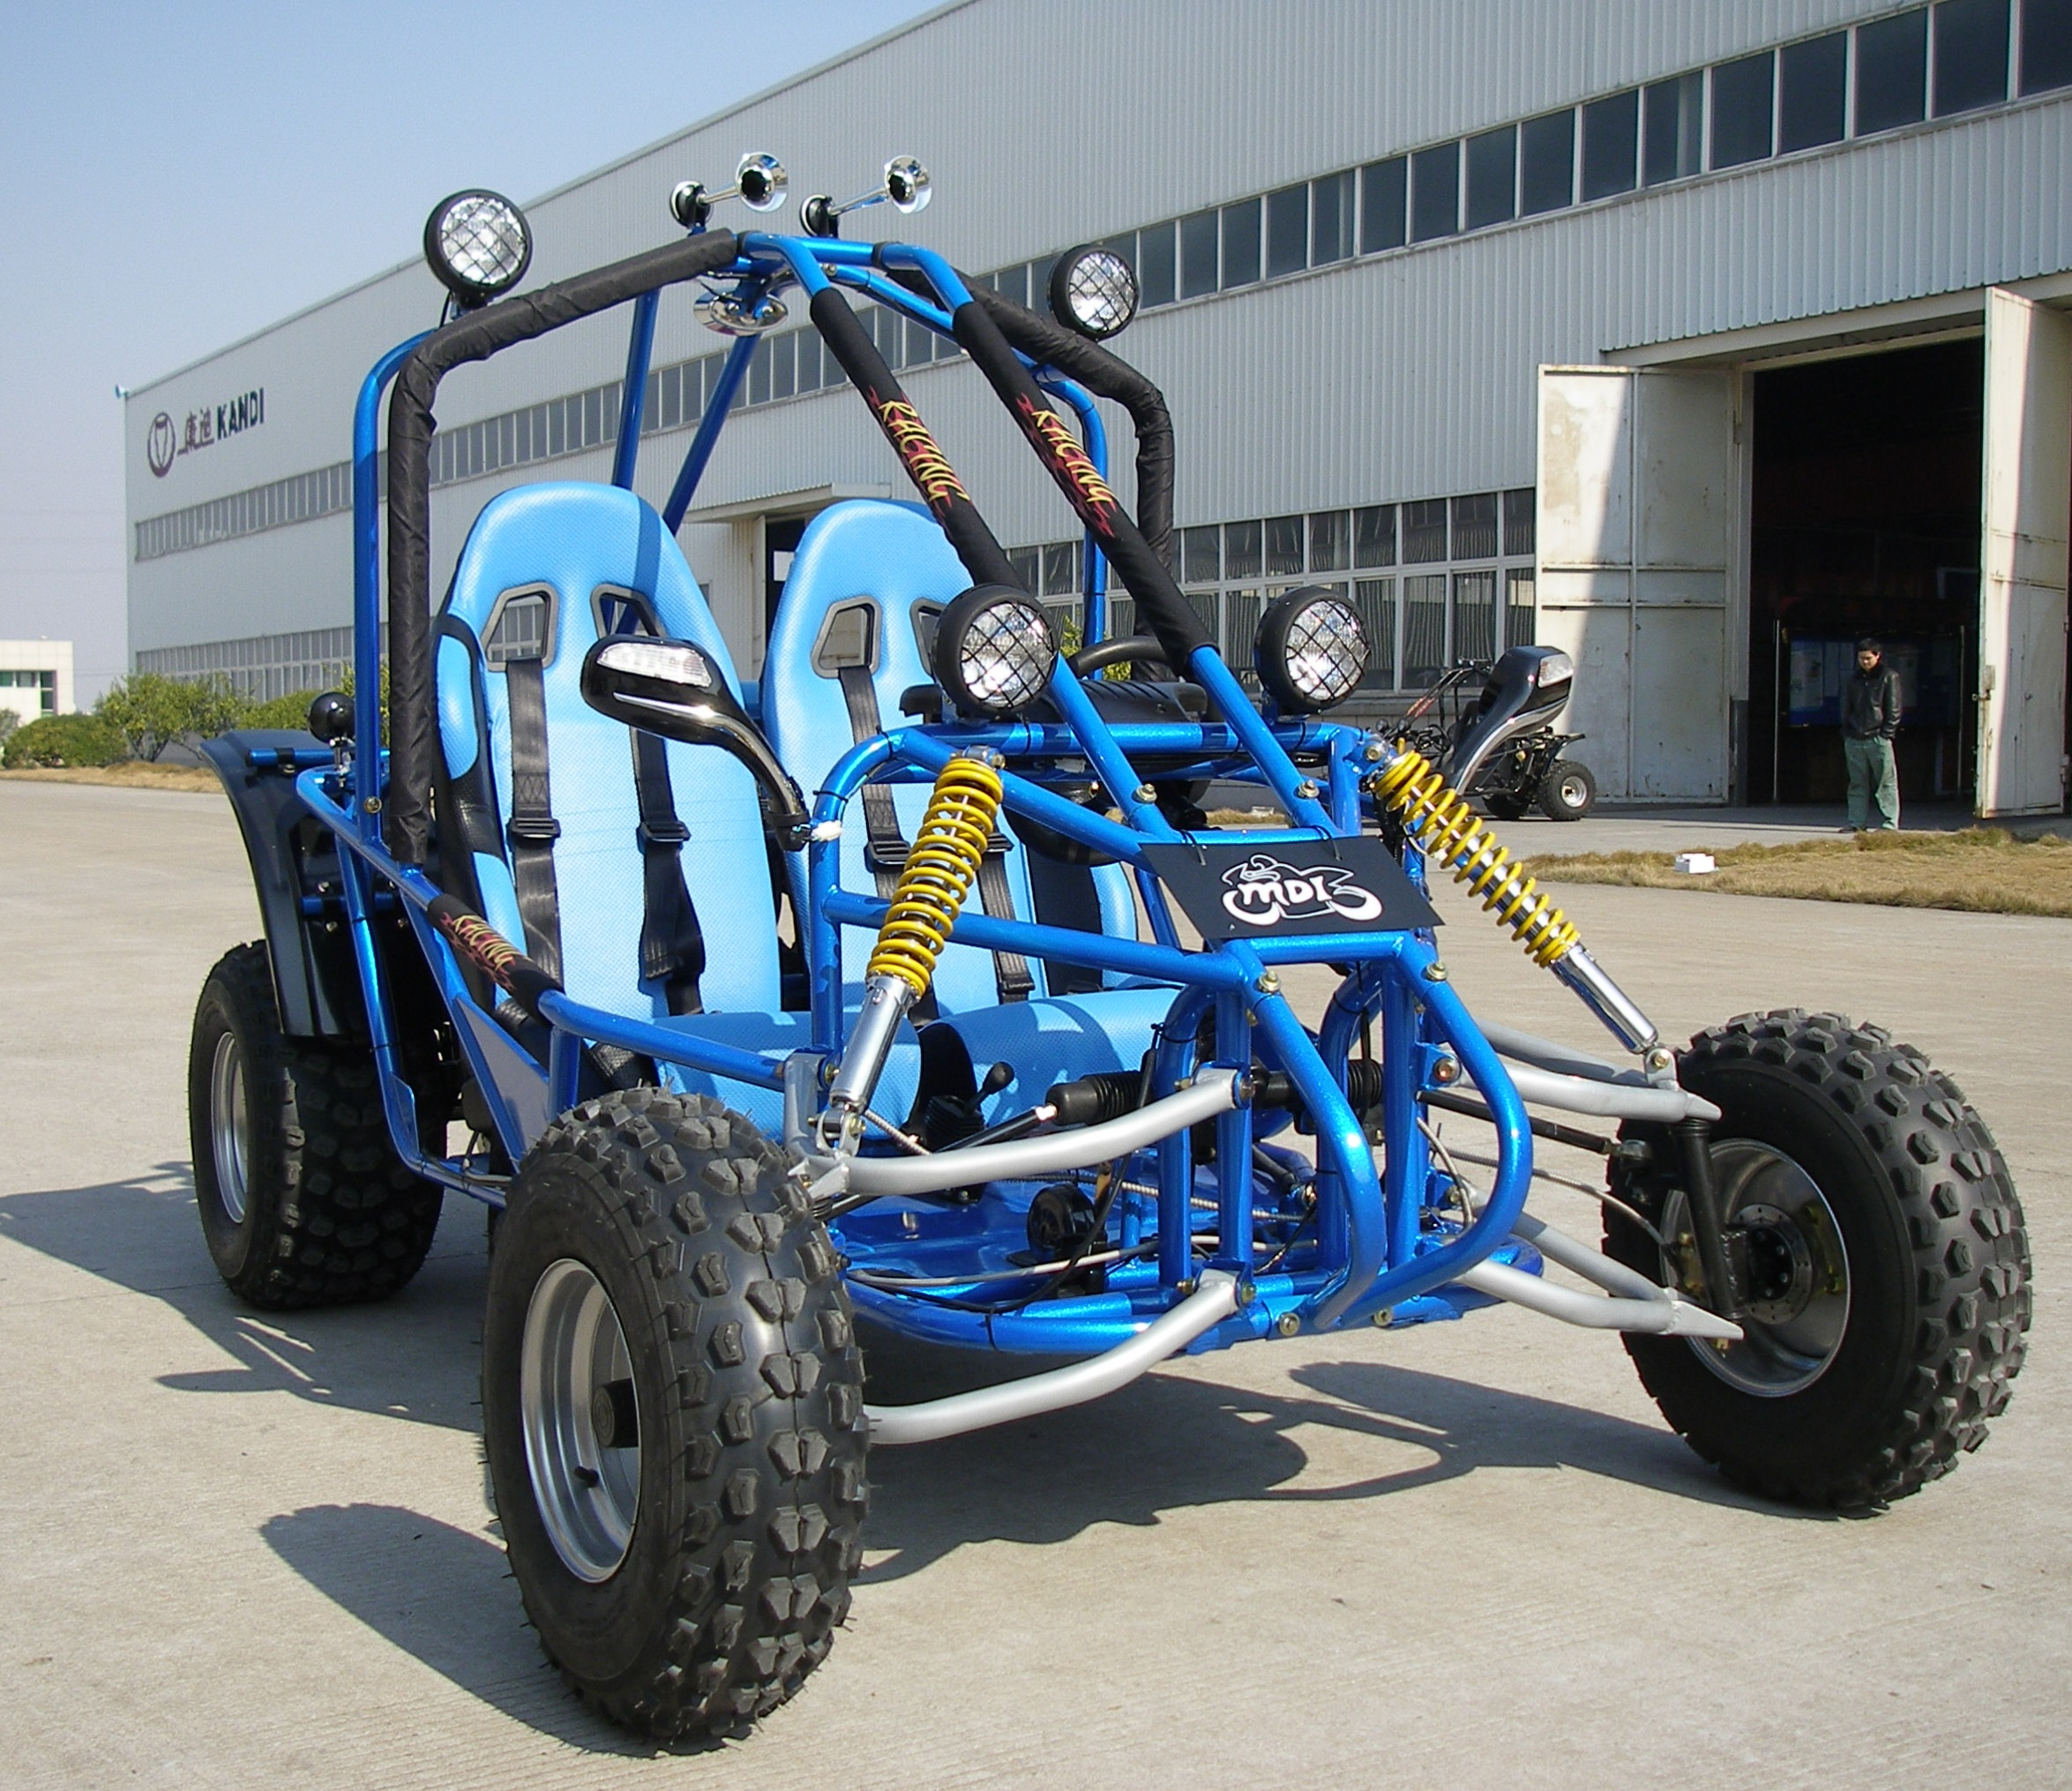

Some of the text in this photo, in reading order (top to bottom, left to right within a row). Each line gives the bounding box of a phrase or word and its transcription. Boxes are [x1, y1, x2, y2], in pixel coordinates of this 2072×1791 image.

[217, 387, 264, 440] KANDI
[879, 400, 970, 502] RACING
[1031, 410, 1117, 503] RACING
[451, 914, 535, 972] RACING
